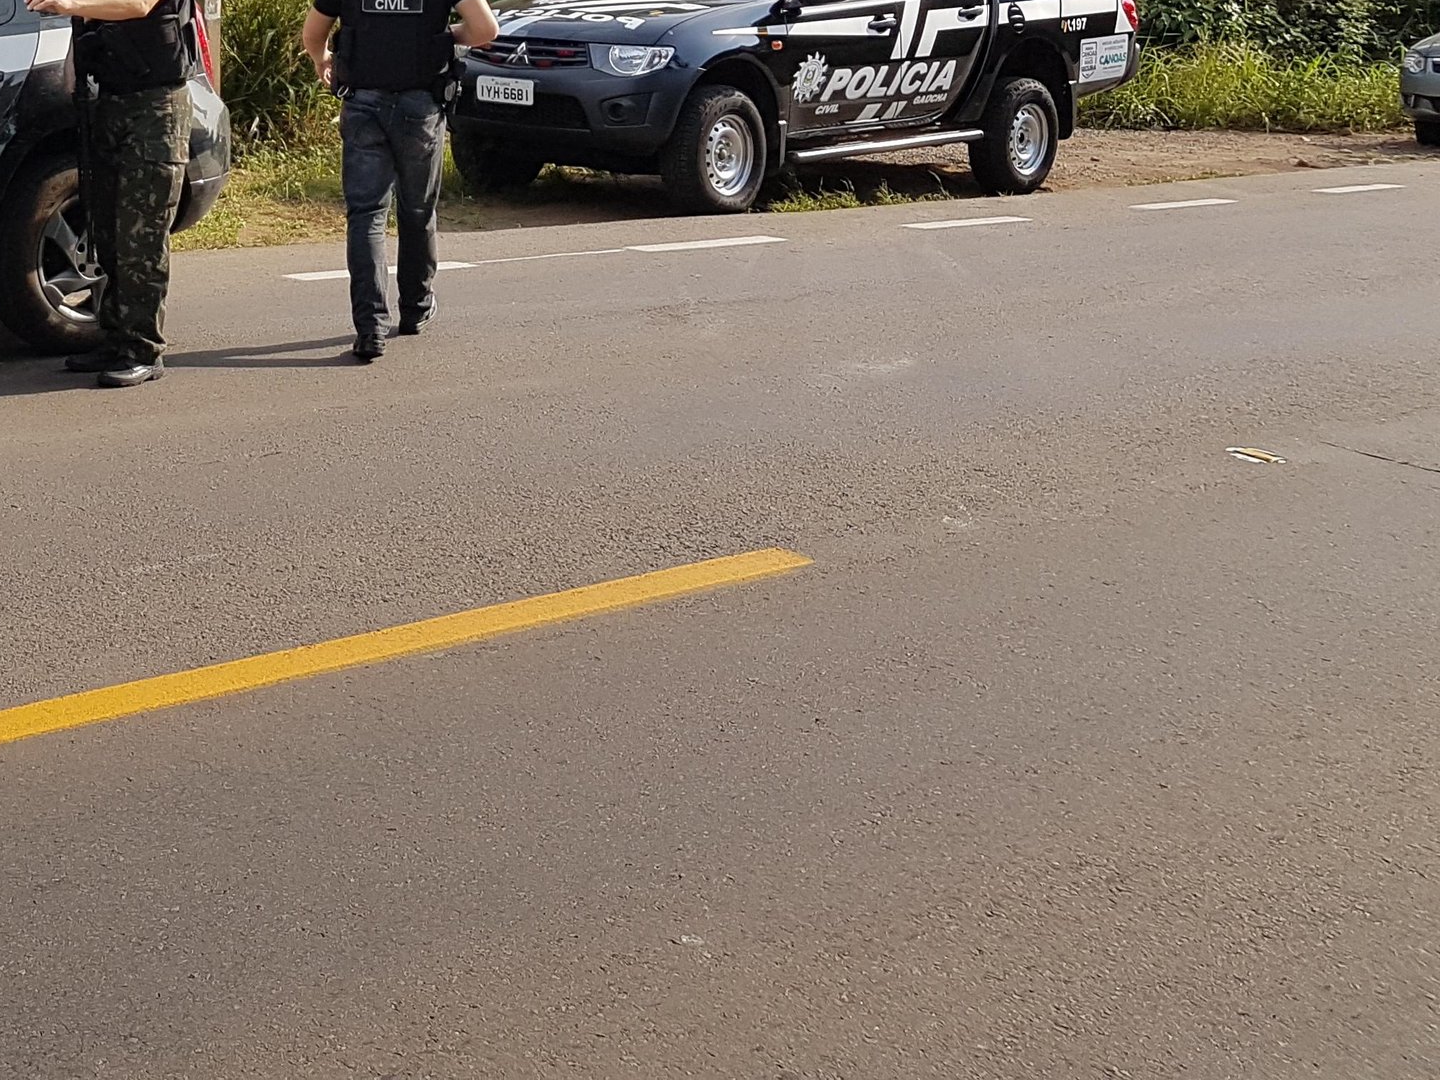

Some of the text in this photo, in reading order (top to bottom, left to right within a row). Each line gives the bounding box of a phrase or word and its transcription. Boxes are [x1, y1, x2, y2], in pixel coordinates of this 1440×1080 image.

[375, 0, 409, 10] CIVIL
[1071, 17, 1087, 31] 197
[1099, 52, 1126, 65] CANOAS
[815, 104, 839, 115] CIVIL
